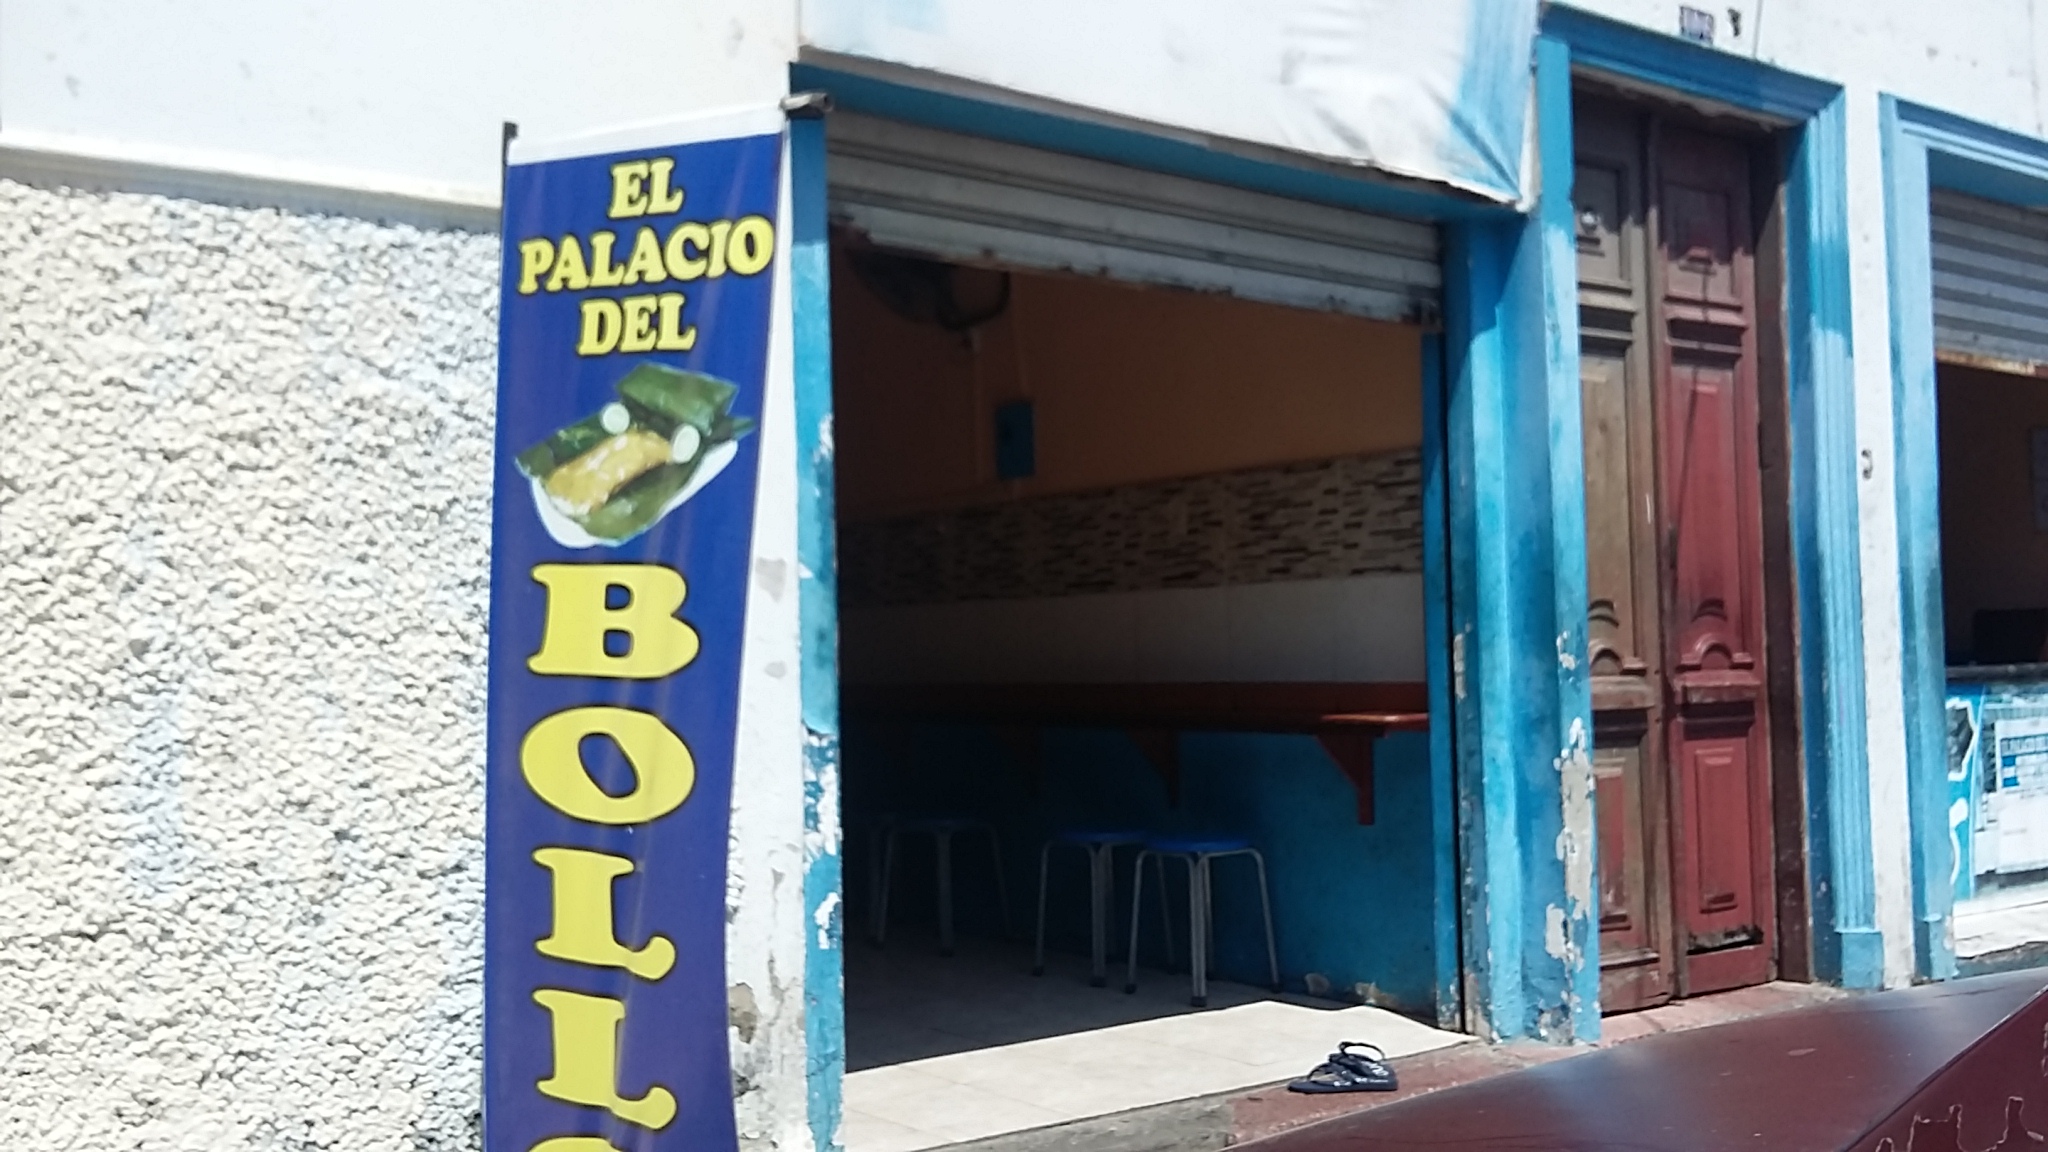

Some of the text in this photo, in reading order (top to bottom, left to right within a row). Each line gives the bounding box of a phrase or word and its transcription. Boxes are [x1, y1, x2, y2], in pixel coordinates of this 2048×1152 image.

[608, 157, 684, 219] EL
[518, 215, 775, 295] PALACIO
[576, 292, 697, 356] DEL
[520, 562, 700, 1152] BOLL
